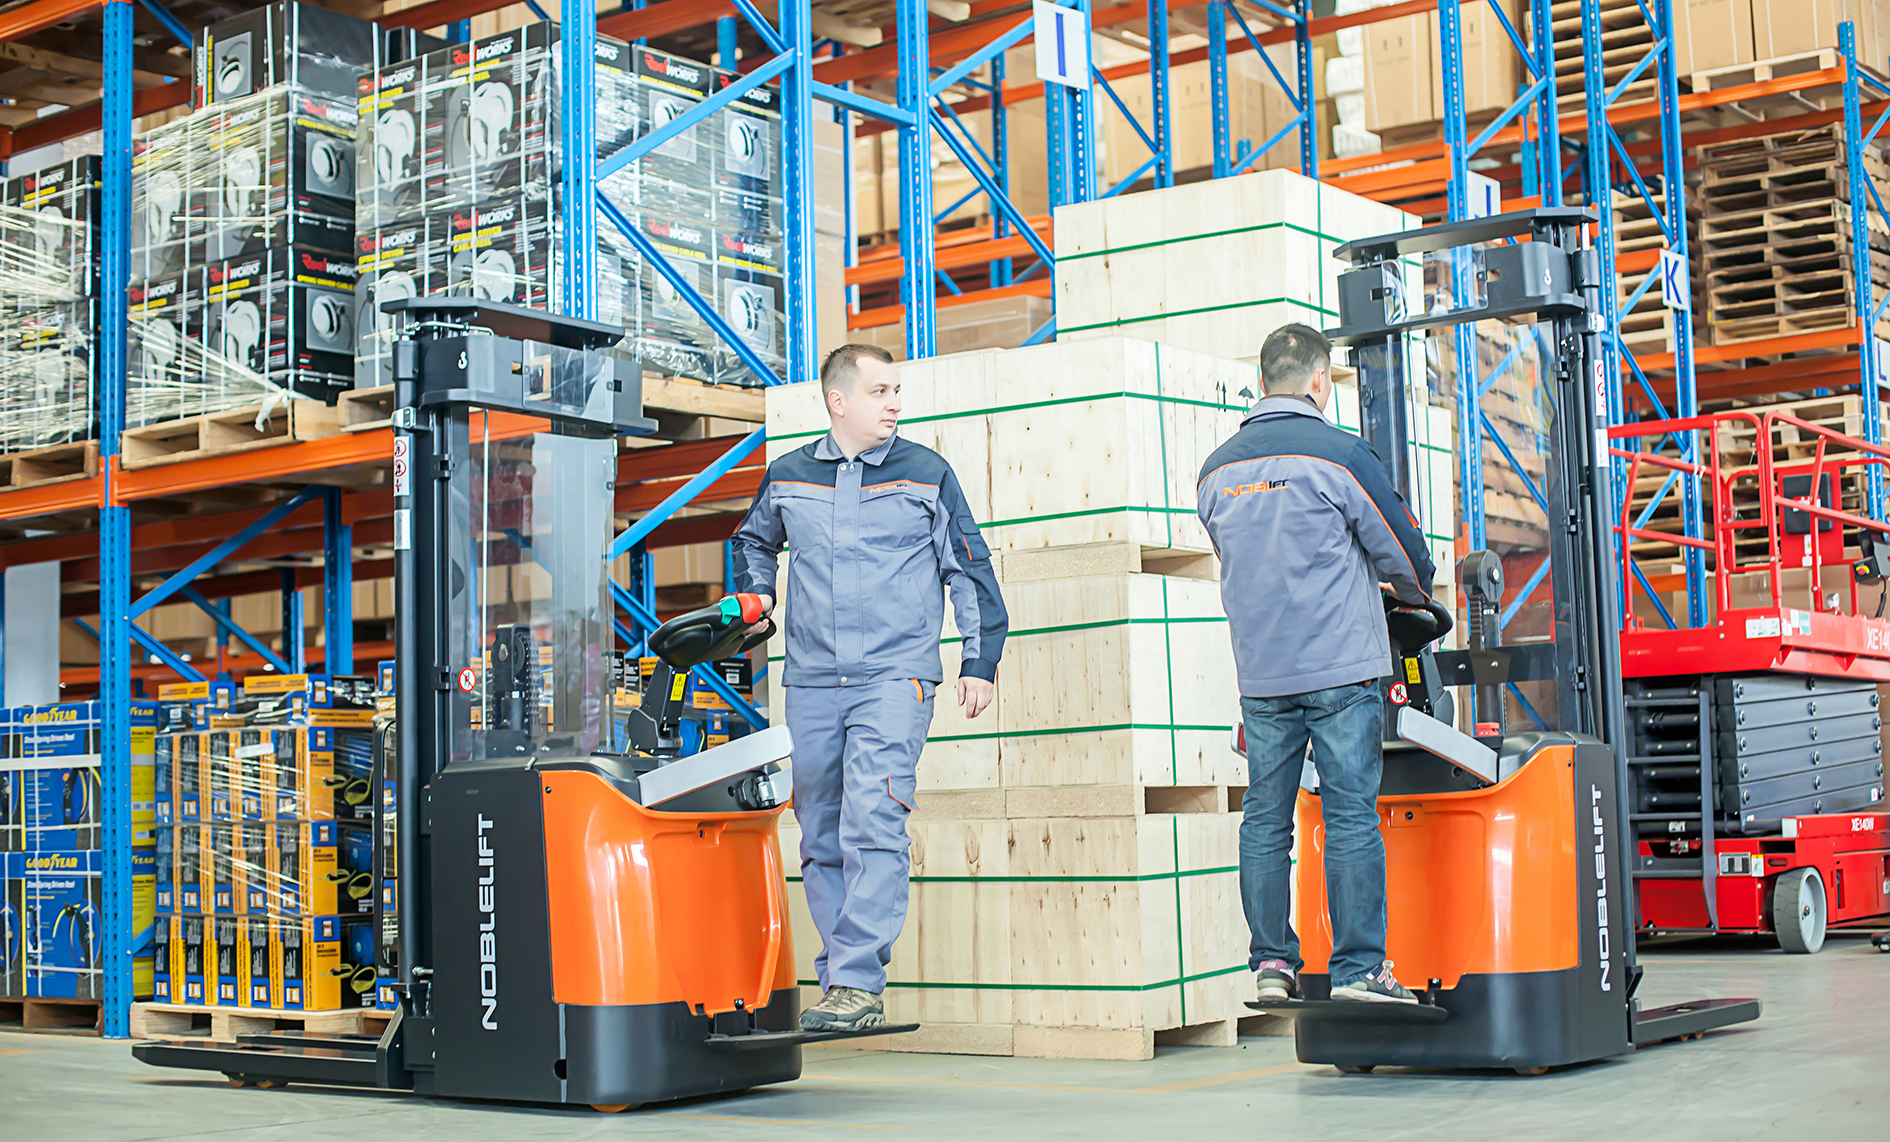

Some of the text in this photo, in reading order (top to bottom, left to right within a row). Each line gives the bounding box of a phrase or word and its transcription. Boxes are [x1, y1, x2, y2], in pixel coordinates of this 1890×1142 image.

[452, 38, 515, 66] RelWORKS
[359, 67, 416, 94] RelWORKS
[453, 206, 516, 231] RelWORKS
[359, 231, 417, 253] RelWORKS
[209, 261, 261, 283] RelWORKS
[1664, 256, 1683, 305] K
[23, 707, 78, 724] GOODYEAR
[26, 853, 78, 871] GOODYEAR
[1591, 783, 1612, 992] NOBLELIFT
[477, 813, 498, 1031] NOBLELIFT
